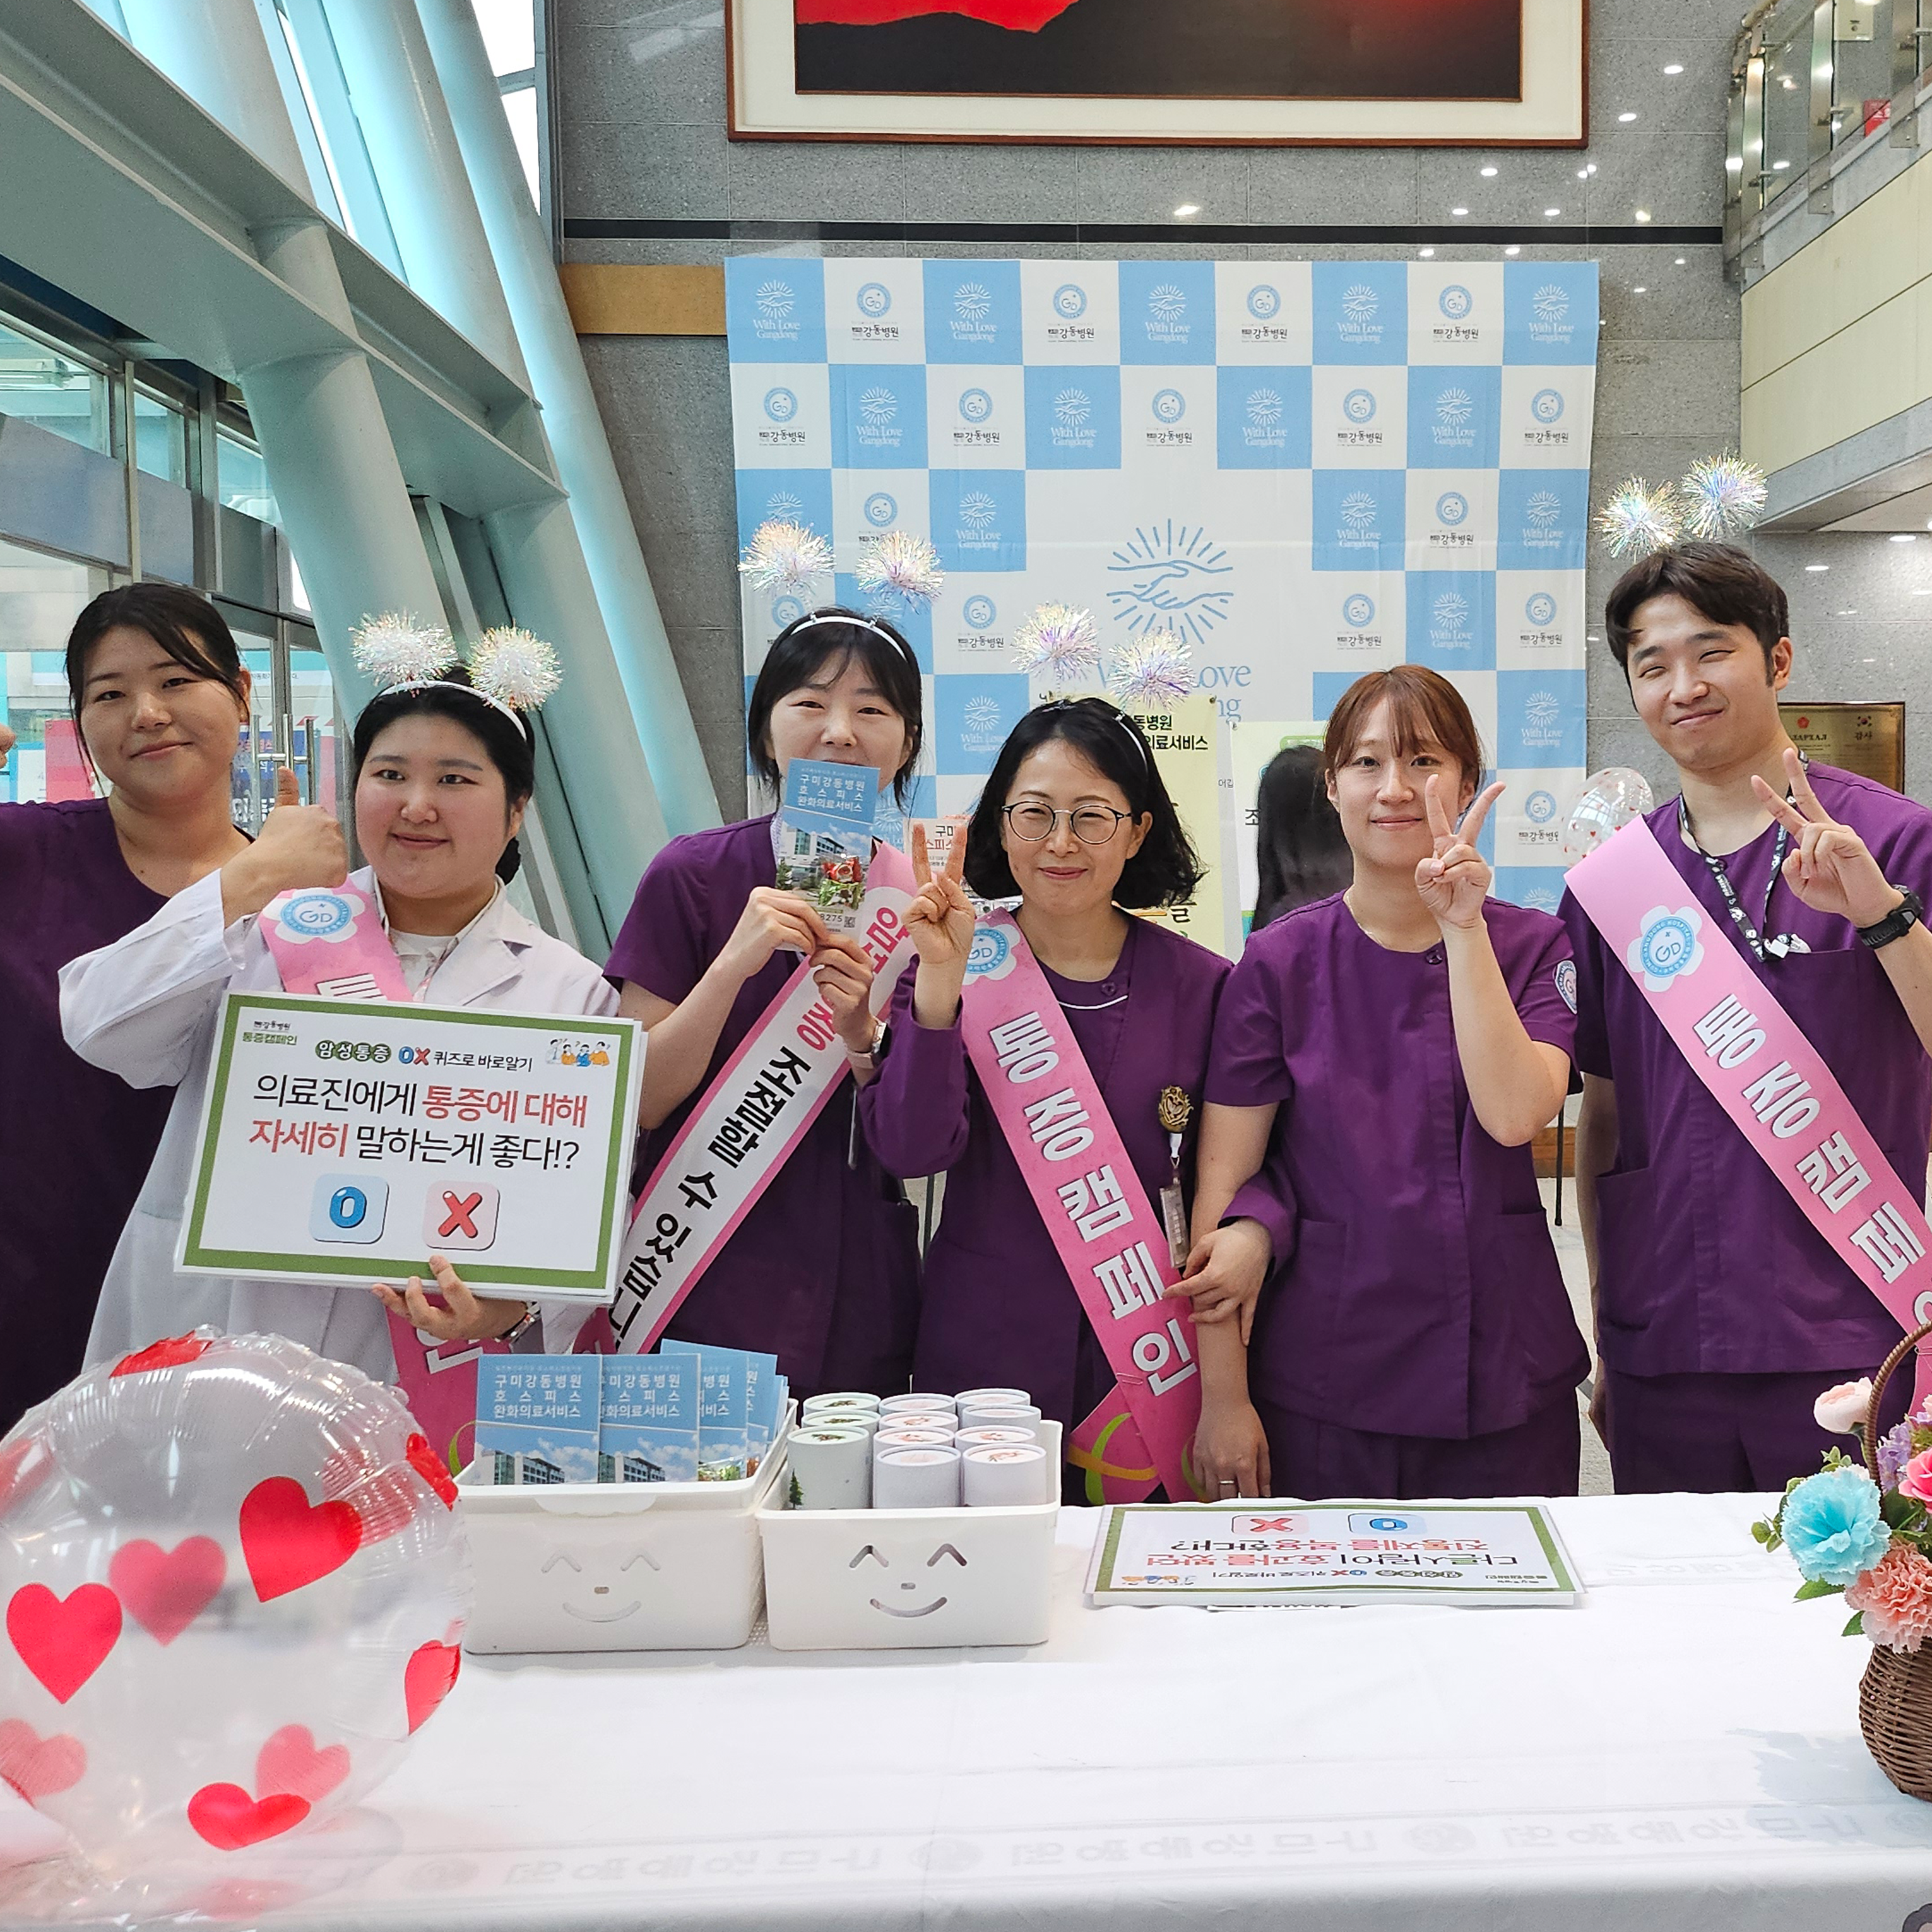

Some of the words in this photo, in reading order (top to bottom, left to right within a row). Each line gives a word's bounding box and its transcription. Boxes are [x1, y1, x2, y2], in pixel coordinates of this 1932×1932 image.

[753, 319, 776, 329] With
[778, 319, 801, 331] Love
[951, 321, 973, 331] With
[976, 321, 997, 332] Love
[1146, 322, 1167, 332] With
[1170, 322, 1191, 333] Love
[1338, 323, 1360, 333] With
[1363, 323, 1384, 333] Love
[1529, 323, 1551, 333] With
[1554, 323, 1575, 333] Love
[756, 331, 798, 341] Gangdong
[954, 332, 995, 343] Gangdong
[1149, 333, 1188, 343] Gangdong
[1341, 333, 1380, 344] Gangdong
[1532, 333, 1572, 344] Gangdong
[856, 425, 878, 436] With
[881, 426, 902, 437] Love
[1051, 427, 1072, 437] With
[1076, 427, 1096, 438] Love
[1243, 427, 1264, 437] With
[1267, 427, 1288, 437] Love
[1432, 426, 1454, 436] With
[1457, 426, 1478, 437] Love
[859, 437, 899, 447] Gangdong
[1053, 438, 1094, 449] Gangdong
[1246, 437, 1285, 448] Gangdong
[1435, 437, 1474, 447] Gangdong
[956, 530, 978, 540] With
[981, 530, 1002, 540] Love
[1337, 529, 1358, 538] With
[1361, 529, 1382, 540] Love
[1522, 528, 1543, 538] With
[1546, 528, 1566, 538] Love
[959, 540, 999, 551] Gangdong
[1340, 540, 1379, 550] Gangdong
[1525, 538, 1563, 549] Gangdong
[1430, 630, 1451, 639] With
[1454, 630, 1474, 640] Love
[1433, 640, 1471, 651] Gangdong
[1521, 727, 1542, 737] With
[1544, 728, 1565, 738] Love
[1524, 738, 1562, 748] Gangdong
[800, 774, 865, 791] 구미강동병원
[798, 785, 863, 801] 호스피스
[797, 796, 862, 812] 완화의료서비스
[299, 910, 333, 923] GD
[1655, 942, 1681, 963] GD
[319, 1041, 389, 1064] 암성통증
[434, 1051, 475, 1067] 퀴즈로
[478, 1055, 533, 1072] 바로알기
[254, 1074, 417, 1117] 의료진에게
[422, 1086, 518, 1123] 통증에
[524, 1093, 587, 1128] 대해
[708, 1045, 812, 1169] 조절할
[249, 1120, 348, 1157] 자세히
[357, 1126, 484, 1166] 말하는게
[490, 1134, 579, 1170] 좋다!?
[678, 1171, 718, 1210] 수
[990, 1011, 1197, 1396] 통증캠페인
[608, 1212, 692, 1352] 있습니
[495, 1374, 582, 1389] 구미강동병원
[494, 1390, 582, 1402] 호스피스
[494, 1404, 581, 1419] 완화의료서비스
[1341, 1554, 1517, 1565] 다른사람이
